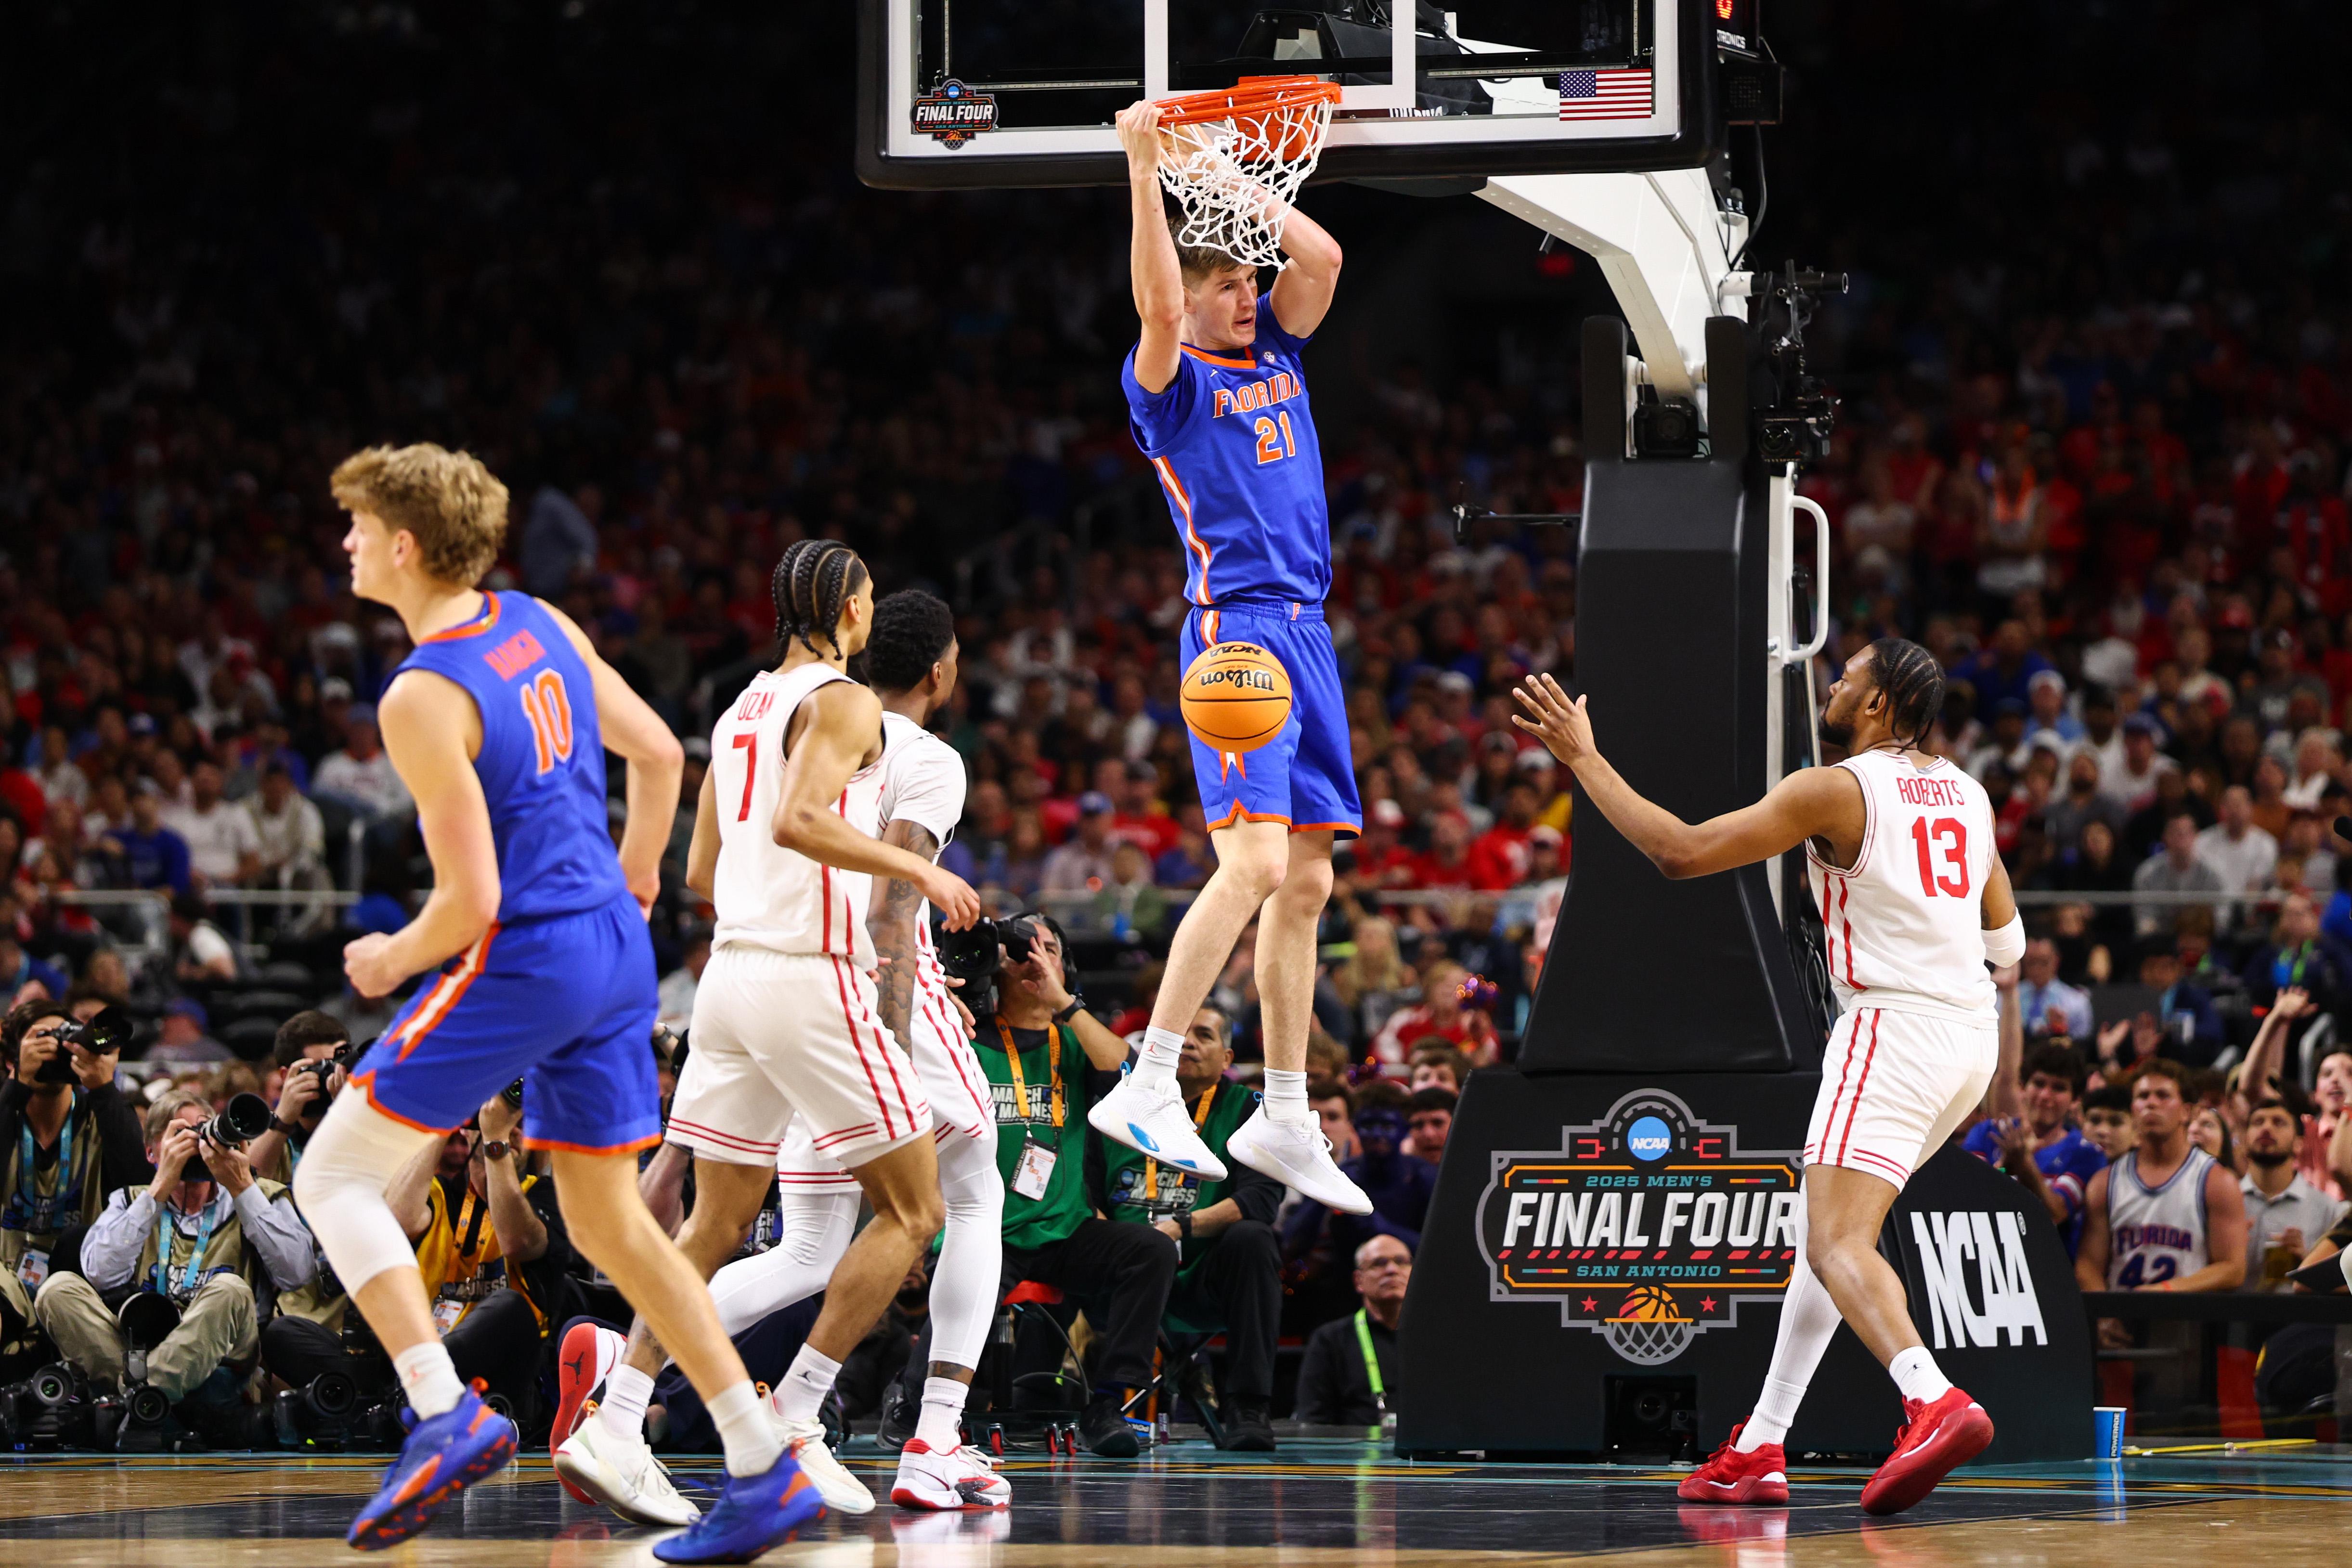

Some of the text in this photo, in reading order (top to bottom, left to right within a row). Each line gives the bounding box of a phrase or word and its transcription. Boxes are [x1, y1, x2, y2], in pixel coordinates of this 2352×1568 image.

[916, 104, 993, 121] FINAL FOUR
[1212, 370, 1303, 418] FLORIDA
[1254, 411, 1296, 465] 21
[1290, 602, 1300, 621] F
[1209, 645, 1261, 657] NCAA
[1200, 669, 1274, 691] Wilson
[520, 667, 574, 777] 10
[732, 730, 757, 822] 7
[1896, 777, 1965, 806] ROBERTS
[1911, 816, 1970, 899] 13
[992, 1086, 1042, 1103] MACH
[998, 1102, 1066, 1118] MANE
[1632, 1137, 1670, 1150] NCAA
[1133, 1172, 1179, 1188] MCH
[1585, 1176, 1713, 1187] 2025 MEN'S
[1130, 1185, 1197, 1204] MNESS
[1503, 1192, 1800, 1247] FINAL FOUR
[2117, 1224, 2192, 1256] FLORIDA
[1576, 1265, 1721, 1277] SAN ANTONIO
[2118, 1252, 2176, 1288] 42
[2110, 1412, 2120, 1457] POWERADE
